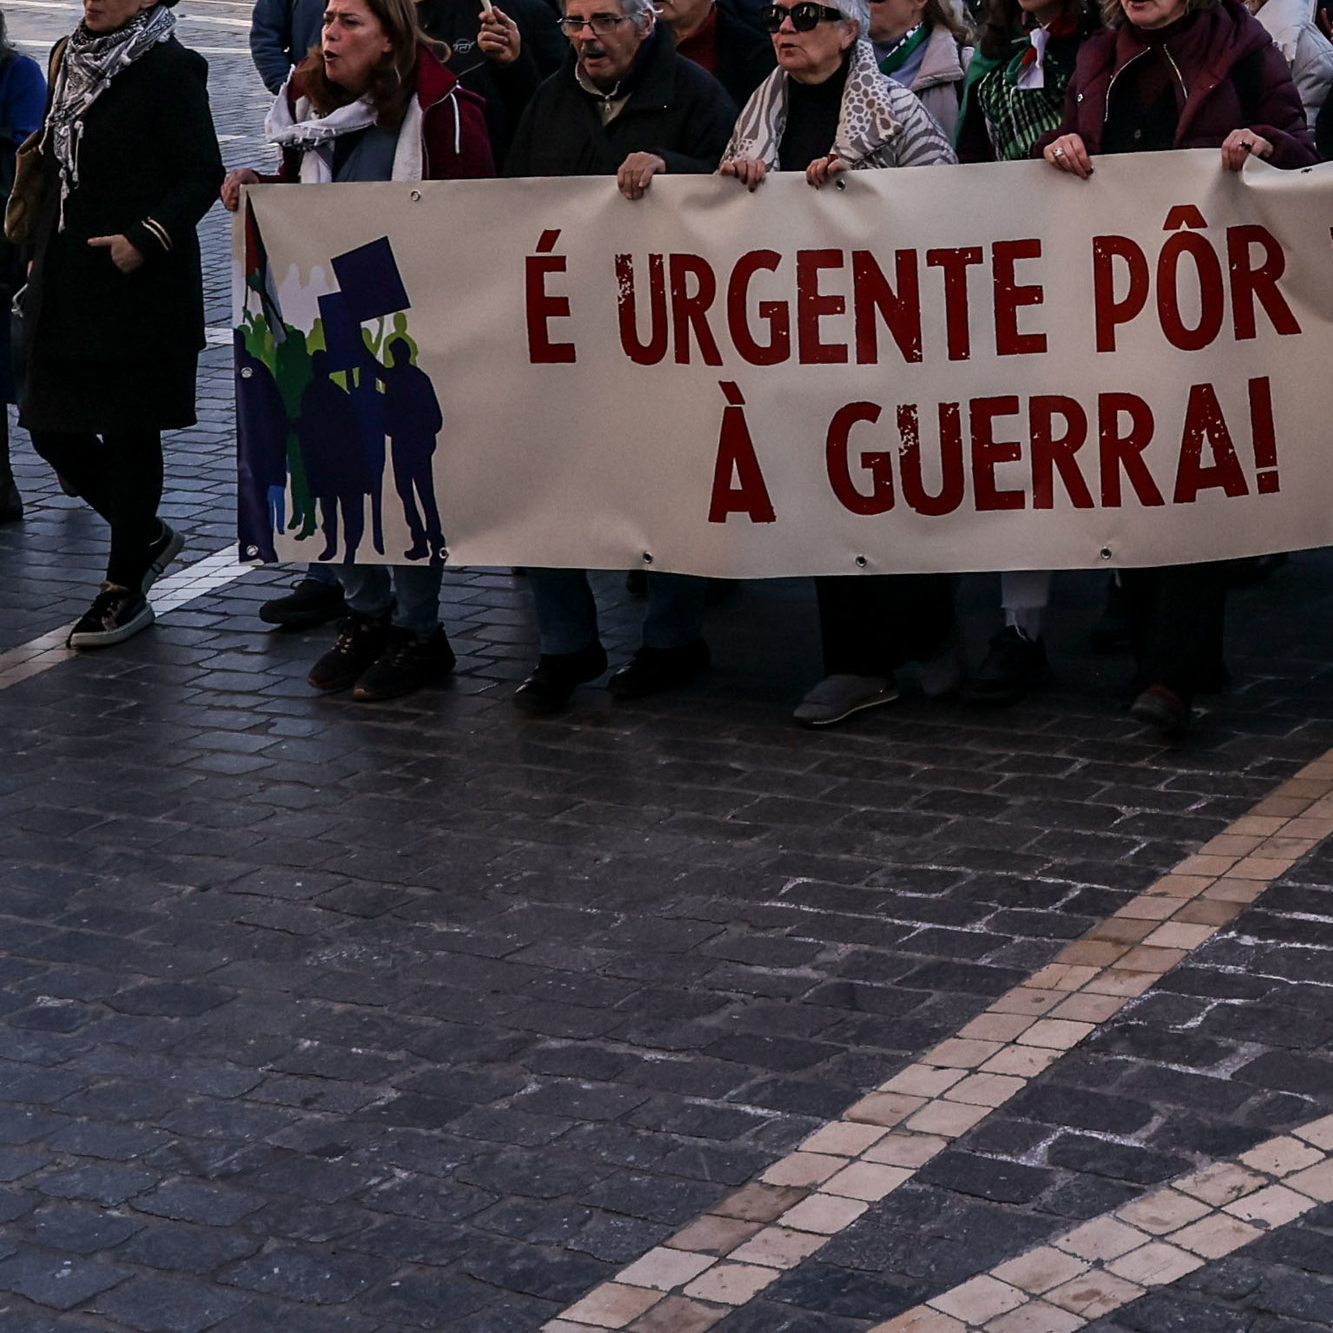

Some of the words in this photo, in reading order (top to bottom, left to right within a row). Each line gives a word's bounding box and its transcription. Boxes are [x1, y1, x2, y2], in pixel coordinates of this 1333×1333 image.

[525, 228, 576, 364] É
[615, 239, 1048, 366] URGENTE
[1093, 204, 1302, 354] PÔR
[708, 380, 777, 523] À
[825, 376, 1281, 517] GUERRA!
